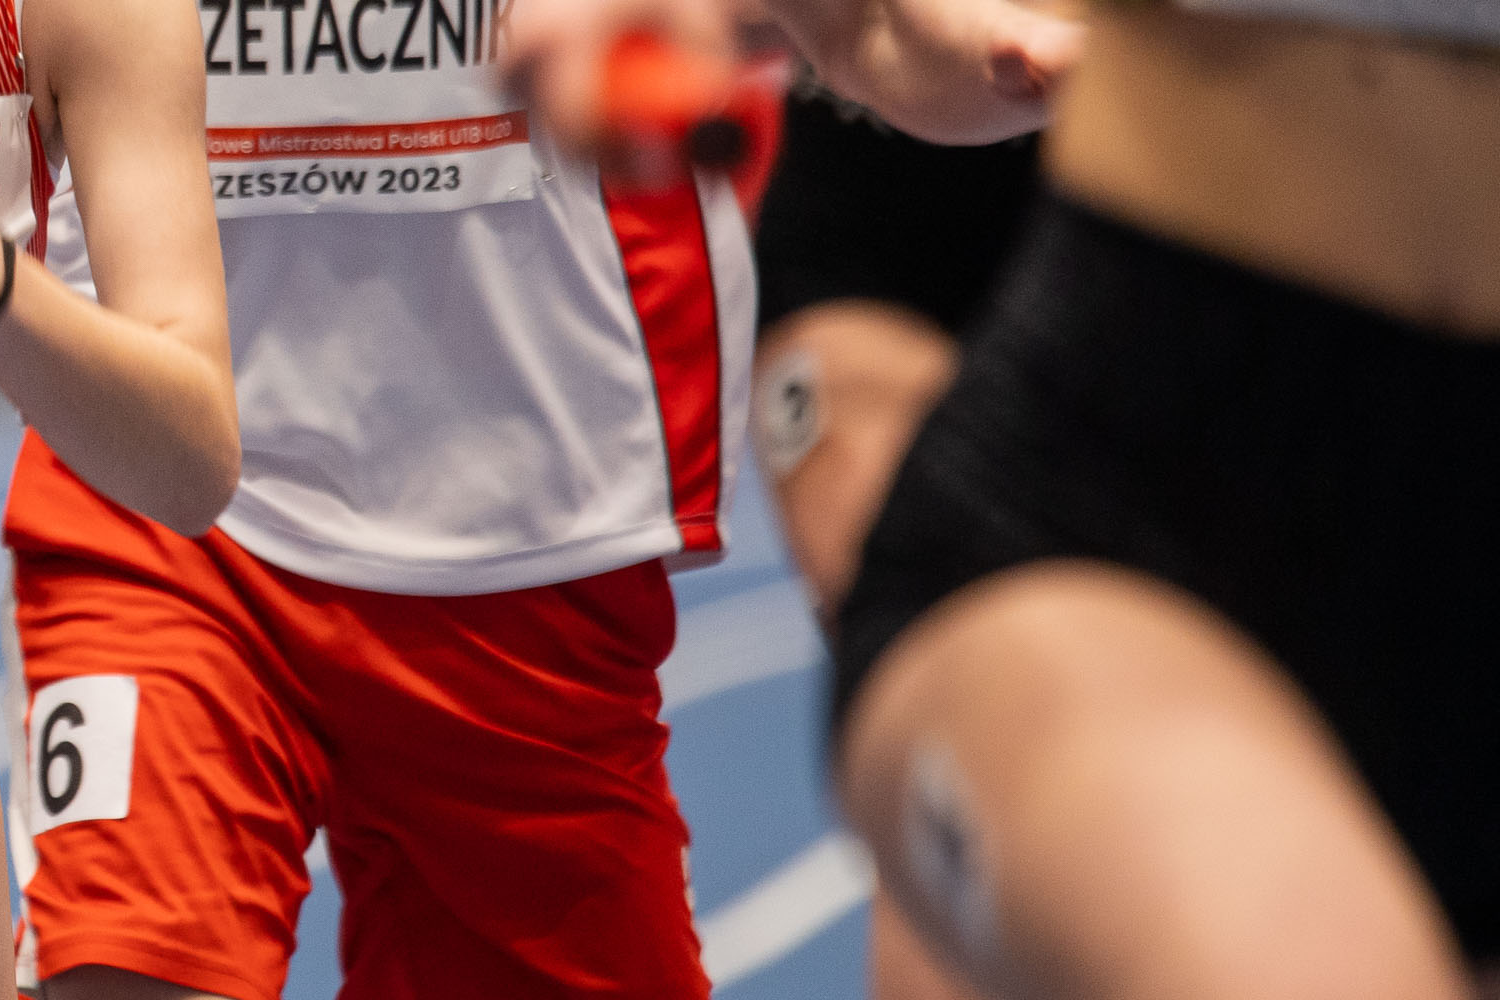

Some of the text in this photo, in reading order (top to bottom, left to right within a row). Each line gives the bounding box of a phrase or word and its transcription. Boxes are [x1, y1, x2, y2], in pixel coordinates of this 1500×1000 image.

[210, 163, 461, 199] ZESZÓW 2023
[38, 701, 86, 816] 6
